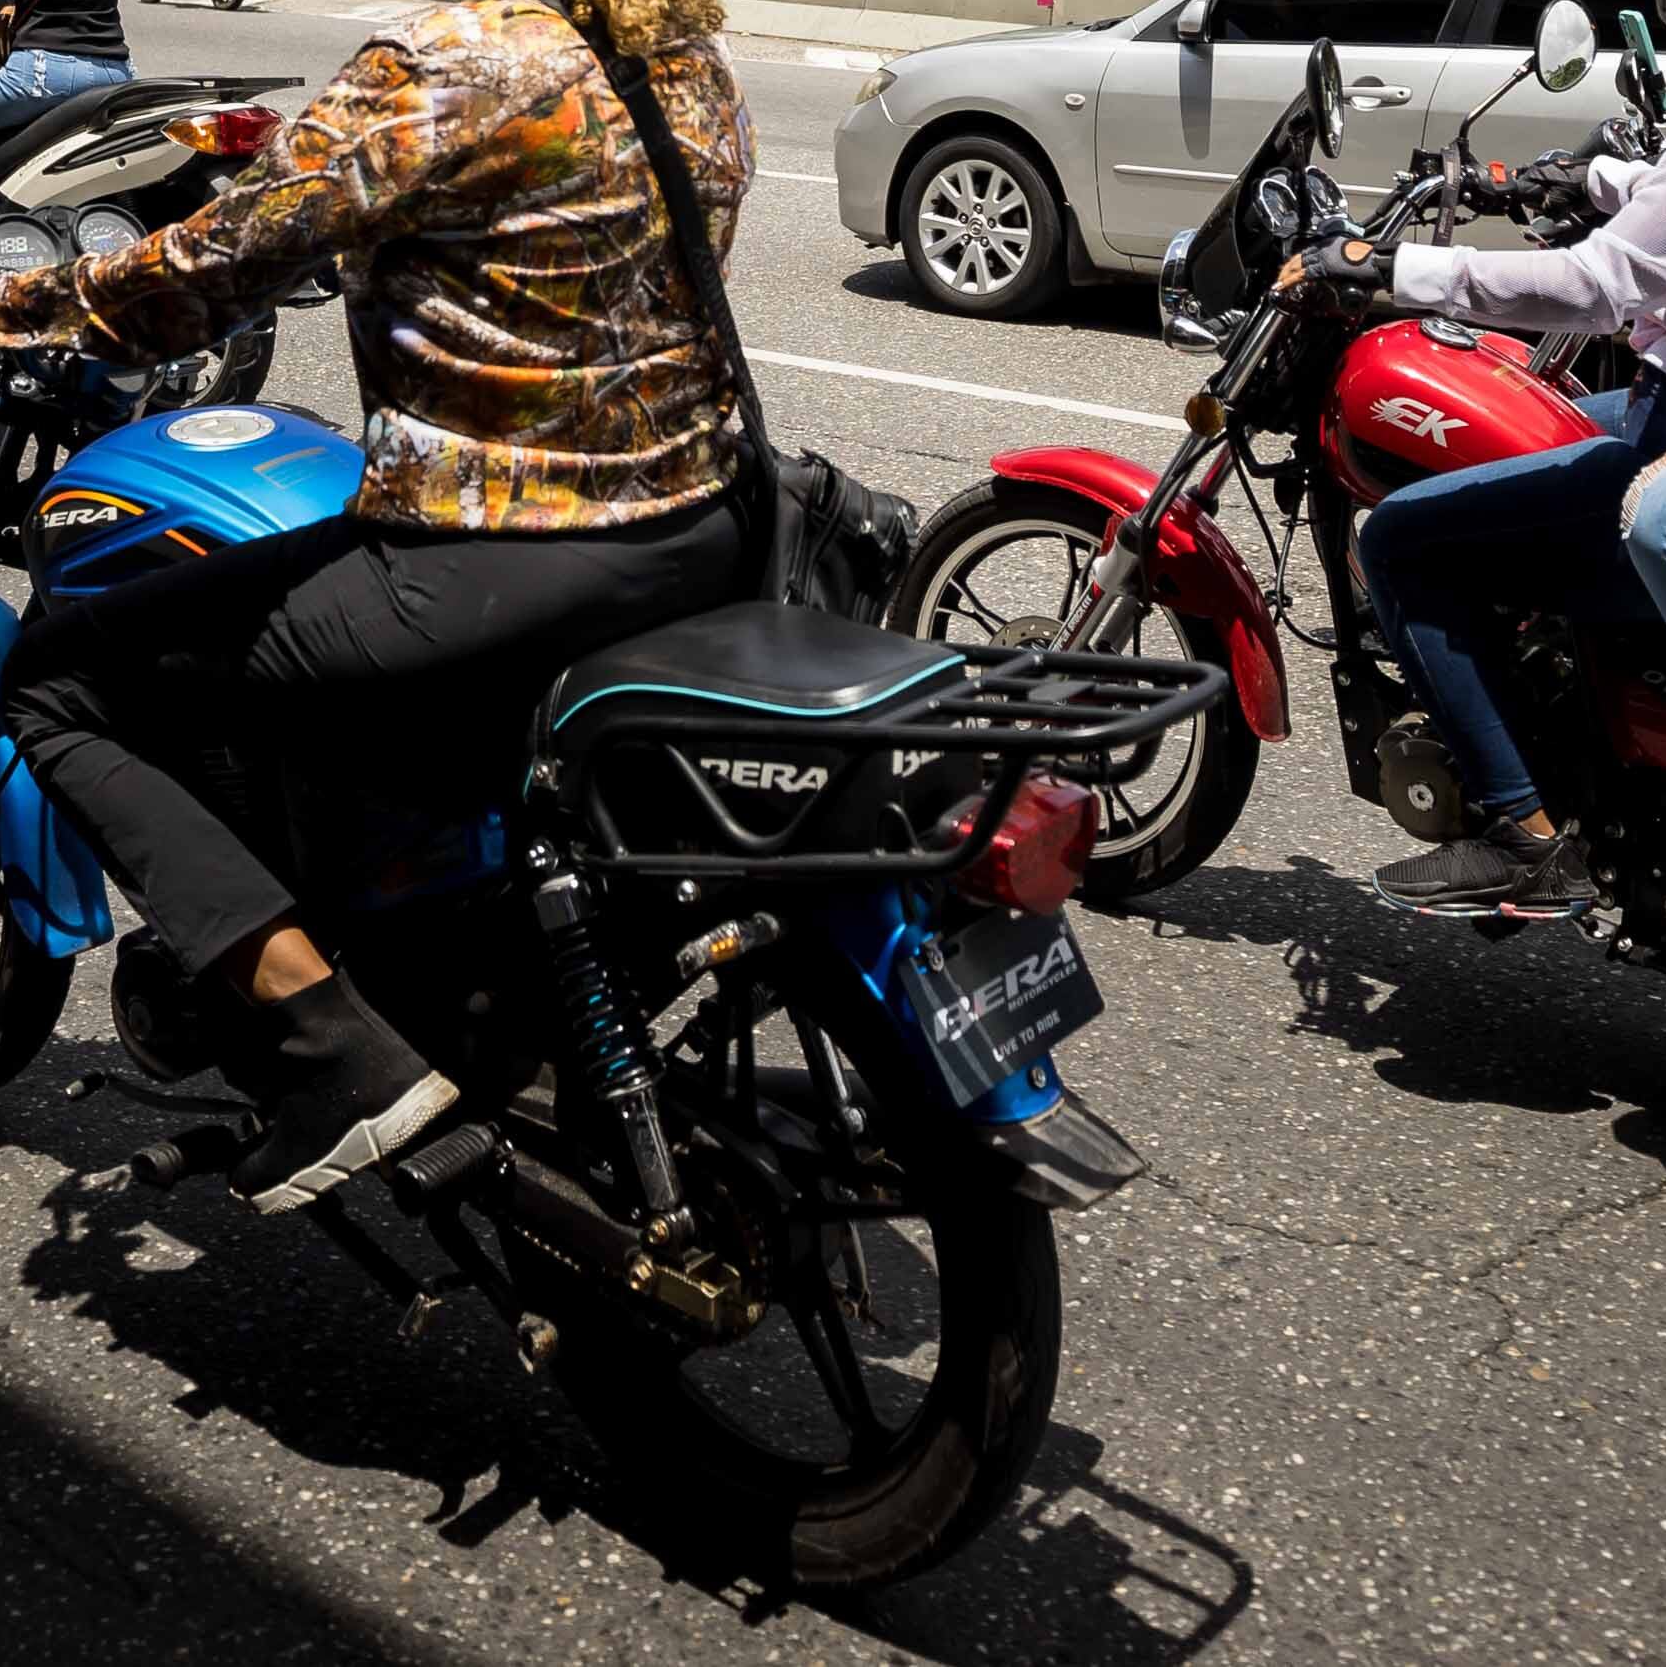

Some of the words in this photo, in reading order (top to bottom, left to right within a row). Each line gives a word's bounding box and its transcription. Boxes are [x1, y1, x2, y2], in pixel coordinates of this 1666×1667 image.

[934, 936, 1075, 1043] BERA
[1007, 961, 1078, 1013] MOTORCYCLES
[1019, 1026, 1035, 1045] TO
[1036, 1009, 1061, 1034] RIDE
